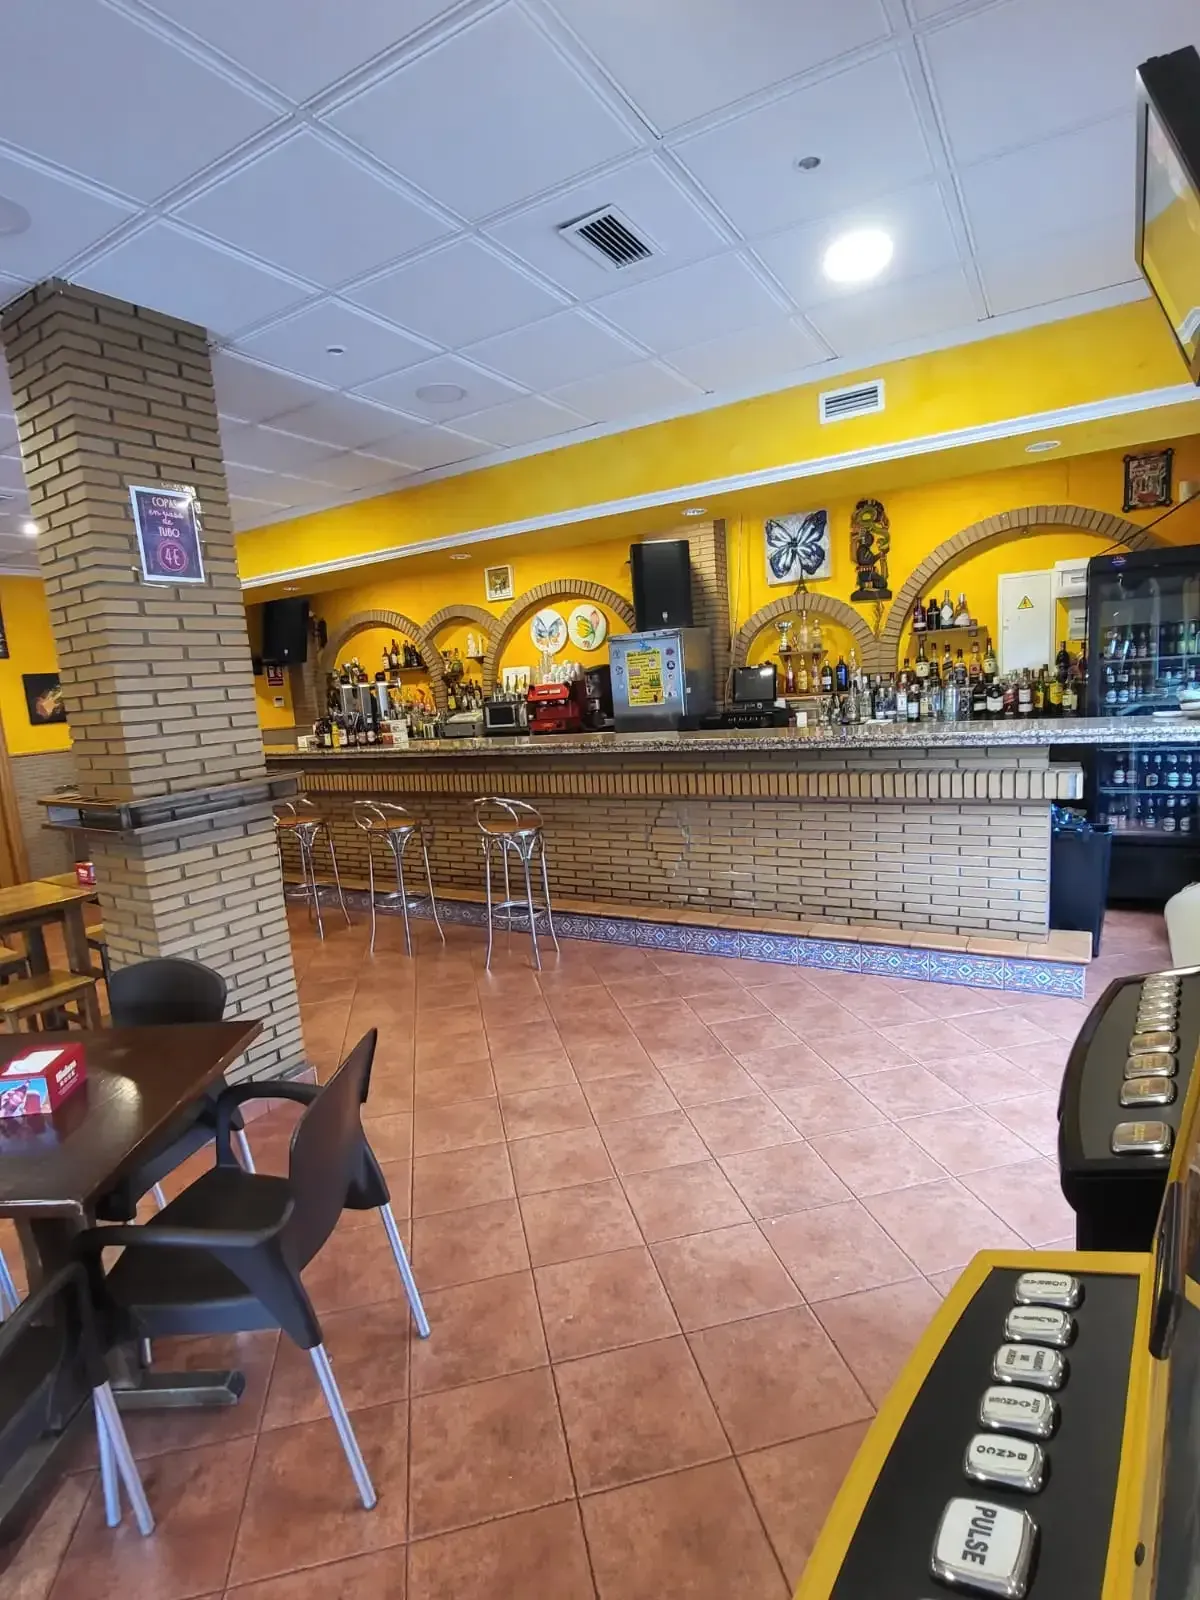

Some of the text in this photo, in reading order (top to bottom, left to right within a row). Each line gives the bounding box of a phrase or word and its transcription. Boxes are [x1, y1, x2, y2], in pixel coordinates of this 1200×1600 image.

[159, 526, 181, 538] TUBO
[165, 547, 181, 566] 4€
[976, 1444, 1028, 1461] BANCO
[961, 1504, 998, 1566] PULSE
